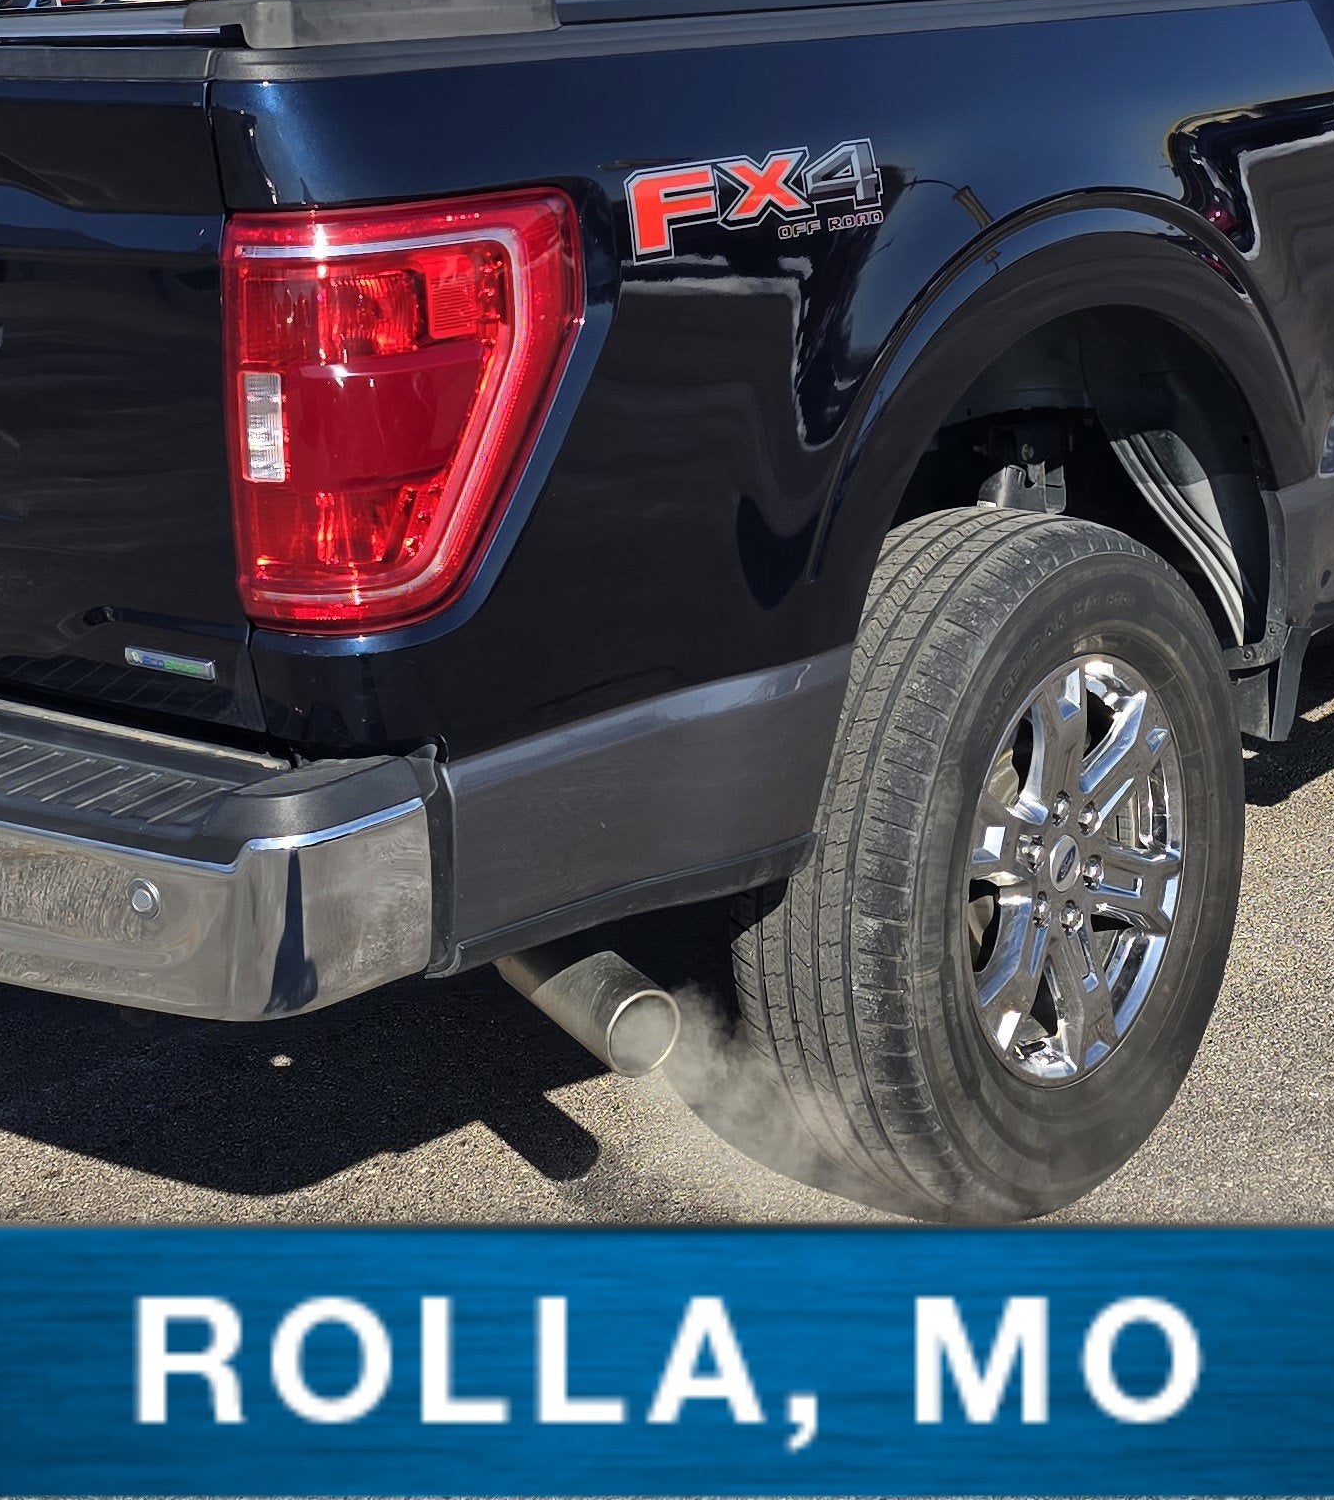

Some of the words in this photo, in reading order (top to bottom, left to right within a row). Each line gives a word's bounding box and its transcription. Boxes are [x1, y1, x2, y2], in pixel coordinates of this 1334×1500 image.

[623, 138, 883, 266] FX4
[778, 220, 821, 240] OFF
[827, 210, 884, 232] ROAD
